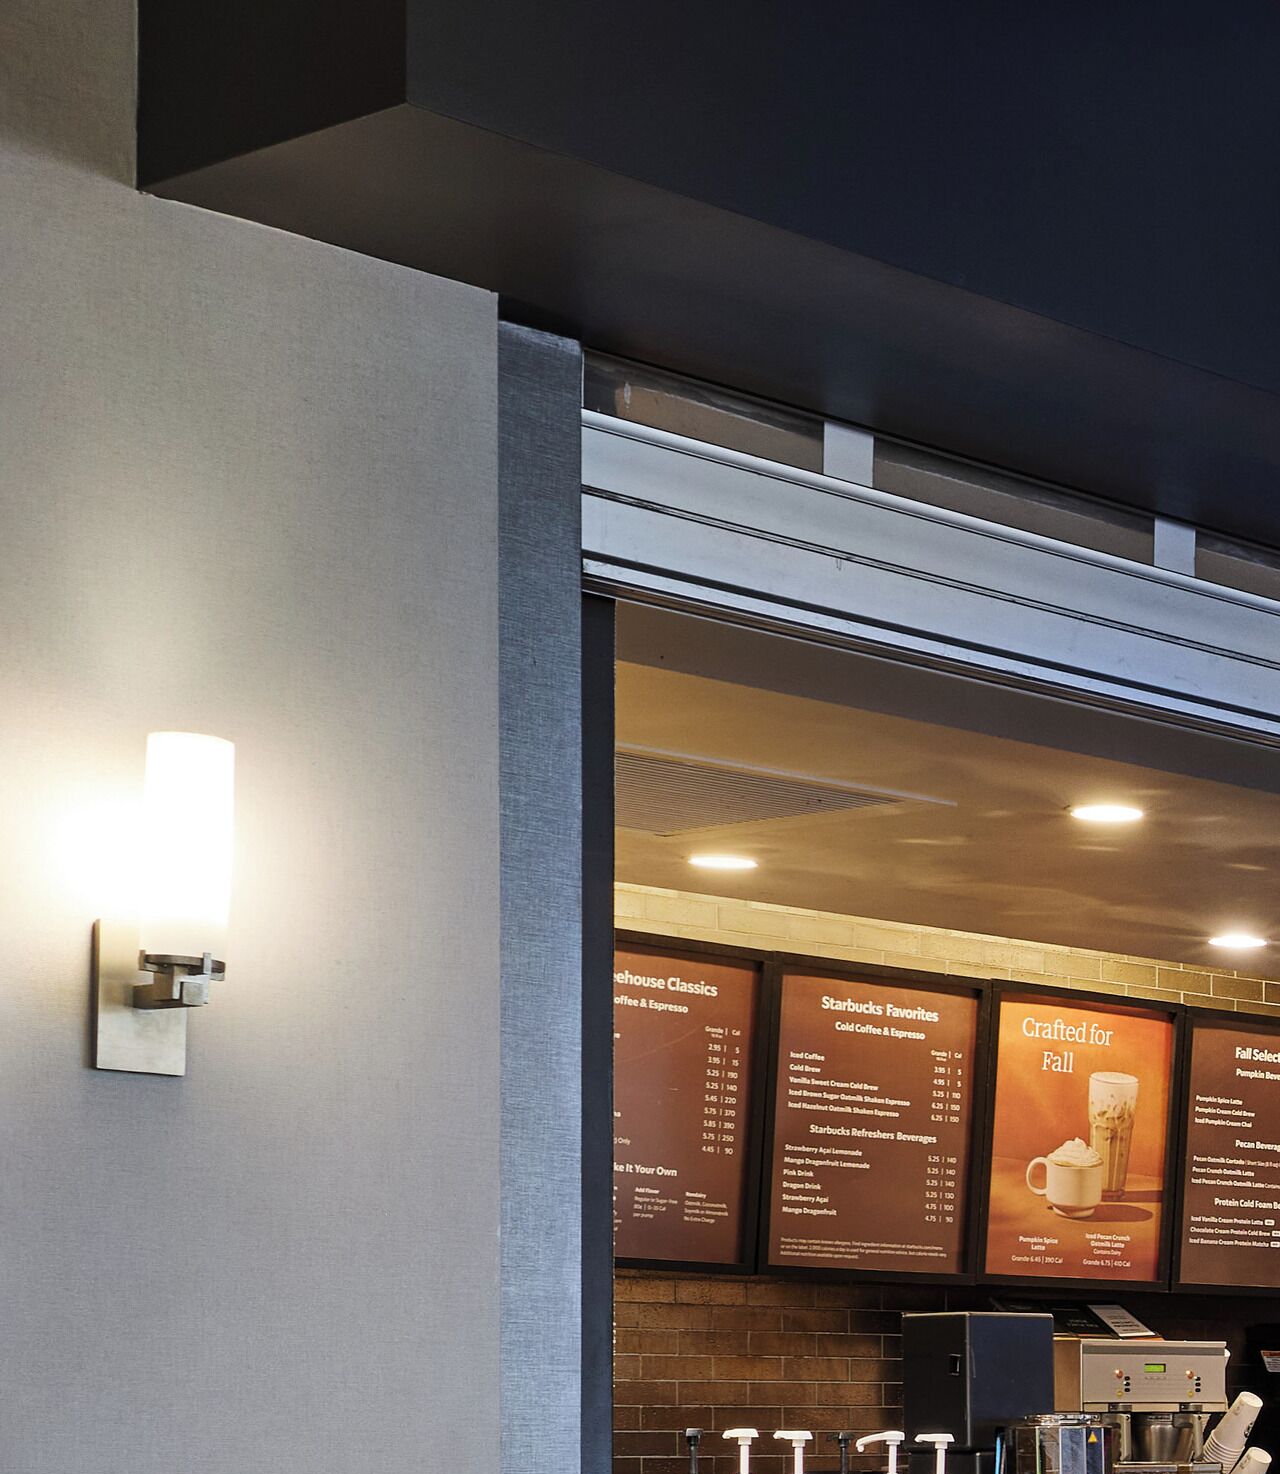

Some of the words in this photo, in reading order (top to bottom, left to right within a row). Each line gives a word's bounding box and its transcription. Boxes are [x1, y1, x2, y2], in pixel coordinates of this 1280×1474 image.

[667, 977, 718, 996] Classics
[614, 995, 639, 1006] offee
[640, 999, 646, 1007] &
[649, 1000, 688, 1013] Espresso
[821, 995, 883, 1016] Starbucks
[886, 1004, 939, 1022] Favorites
[835, 1022, 854, 1032] Cold
[855, 1024, 882, 1036] Coffee
[883, 1027, 890, 1036] &
[891, 1028, 925, 1040] Espresso
[1022, 1017, 1086, 1043] Crafted
[1089, 1024, 1113, 1046] for
[805, 1052, 825, 1061] Coffee
[1235, 1047, 1252, 1060] Fall
[789, 1064, 804, 1072] Cold
[1041, 1051, 1073, 1073] Fall
[1236, 1068, 1265, 1079] Pumpkin
[809, 1124, 850, 1136] Starbucks
[851, 1128, 894, 1140] Refreshers
[897, 1132, 937, 1145] Beverages
[1235, 1140, 1255, 1149] Pecan
[614, 1163, 624, 1171] ke
[626, 1164, 633, 1172] It
[635, 1164, 655, 1174] Your
[656, 1167, 677, 1176] Own
[1214, 1198, 1239, 1208] Protein
[1240, 1200, 1254, 1208] Cold
[1255, 1201, 1272, 1209] Foam
